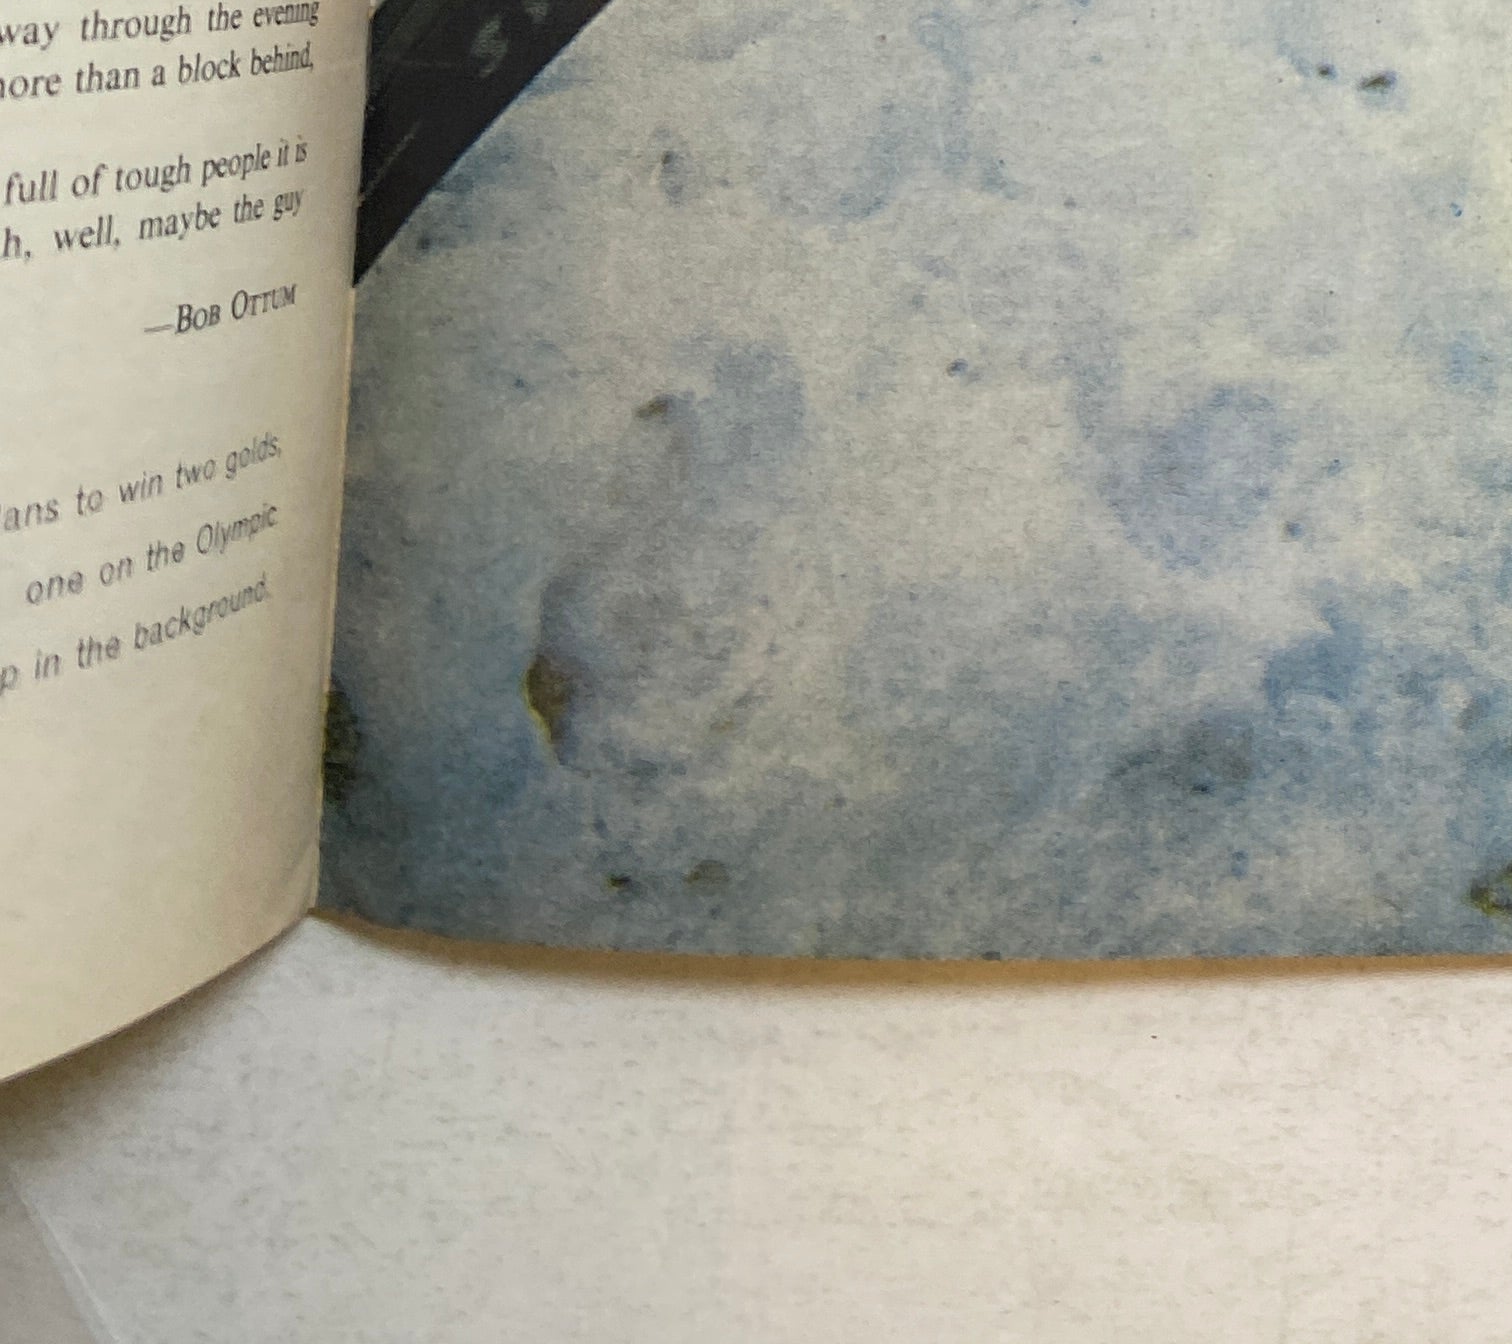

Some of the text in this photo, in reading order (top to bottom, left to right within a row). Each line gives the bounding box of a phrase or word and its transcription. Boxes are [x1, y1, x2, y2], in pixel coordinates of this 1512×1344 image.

[81, 5, 191, 43] through
[208, 2, 242, 32] the
[75, 62, 139, 94] than
[178, 51, 240, 84] block
[4, 141, 271, 206] full tough people
[139, 199, 221, 242] maybe
[273, 188, 305, 222] guy
[76, 485, 103, 516] to
[119, 471, 163, 502] win
[176, 459, 216, 489] two
[26, 571, 84, 604] one
[146, 540, 184, 572] the
[34, 648, 61, 679] in
[76, 635, 120, 669] the
